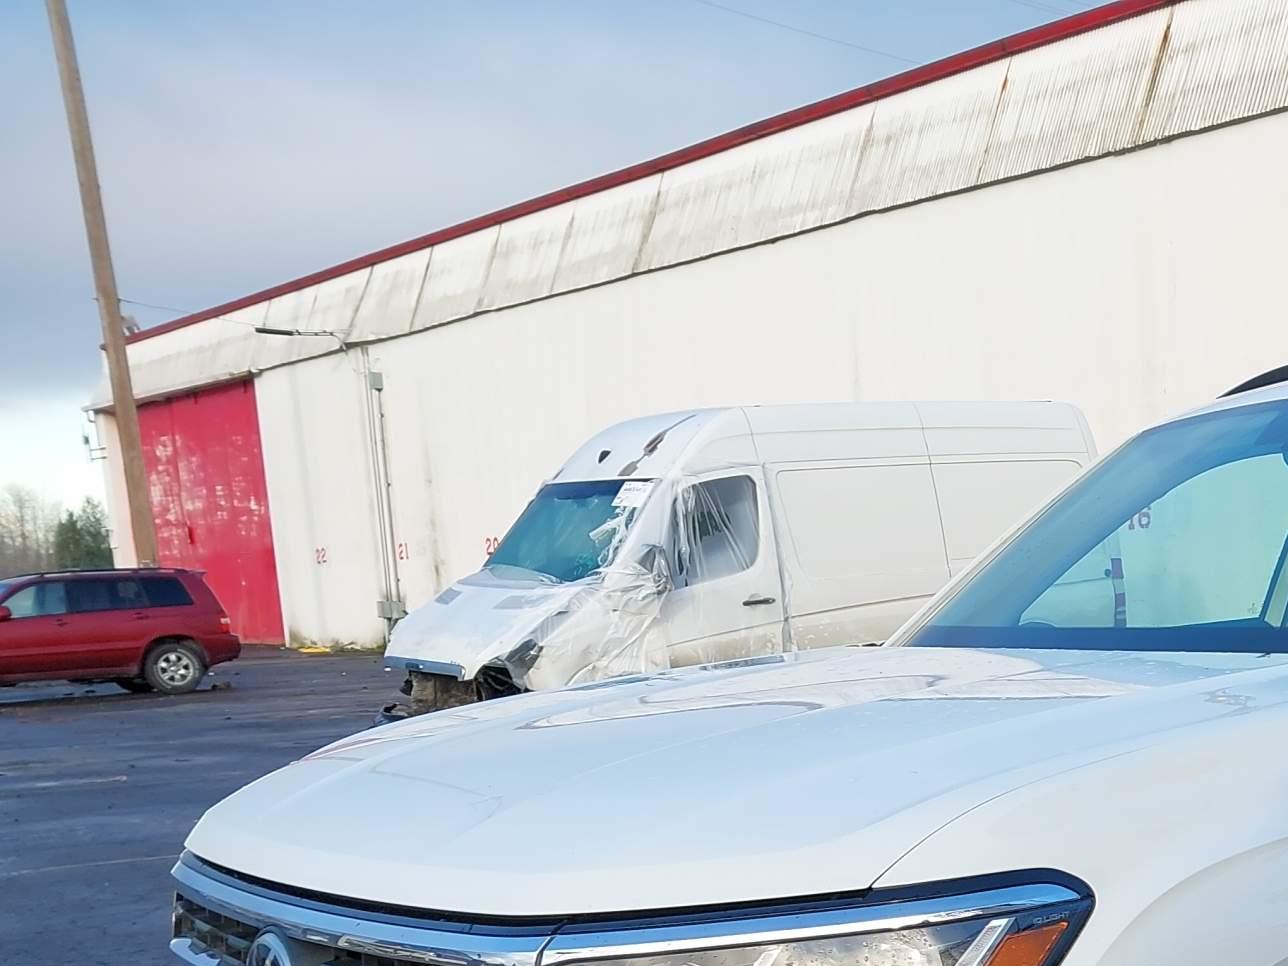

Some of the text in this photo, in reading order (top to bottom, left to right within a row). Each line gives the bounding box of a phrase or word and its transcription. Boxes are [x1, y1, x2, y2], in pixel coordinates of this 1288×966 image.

[398, 542, 409, 560] 21
[485, 536, 500, 556] 20
[315, 547, 327, 564] 22
